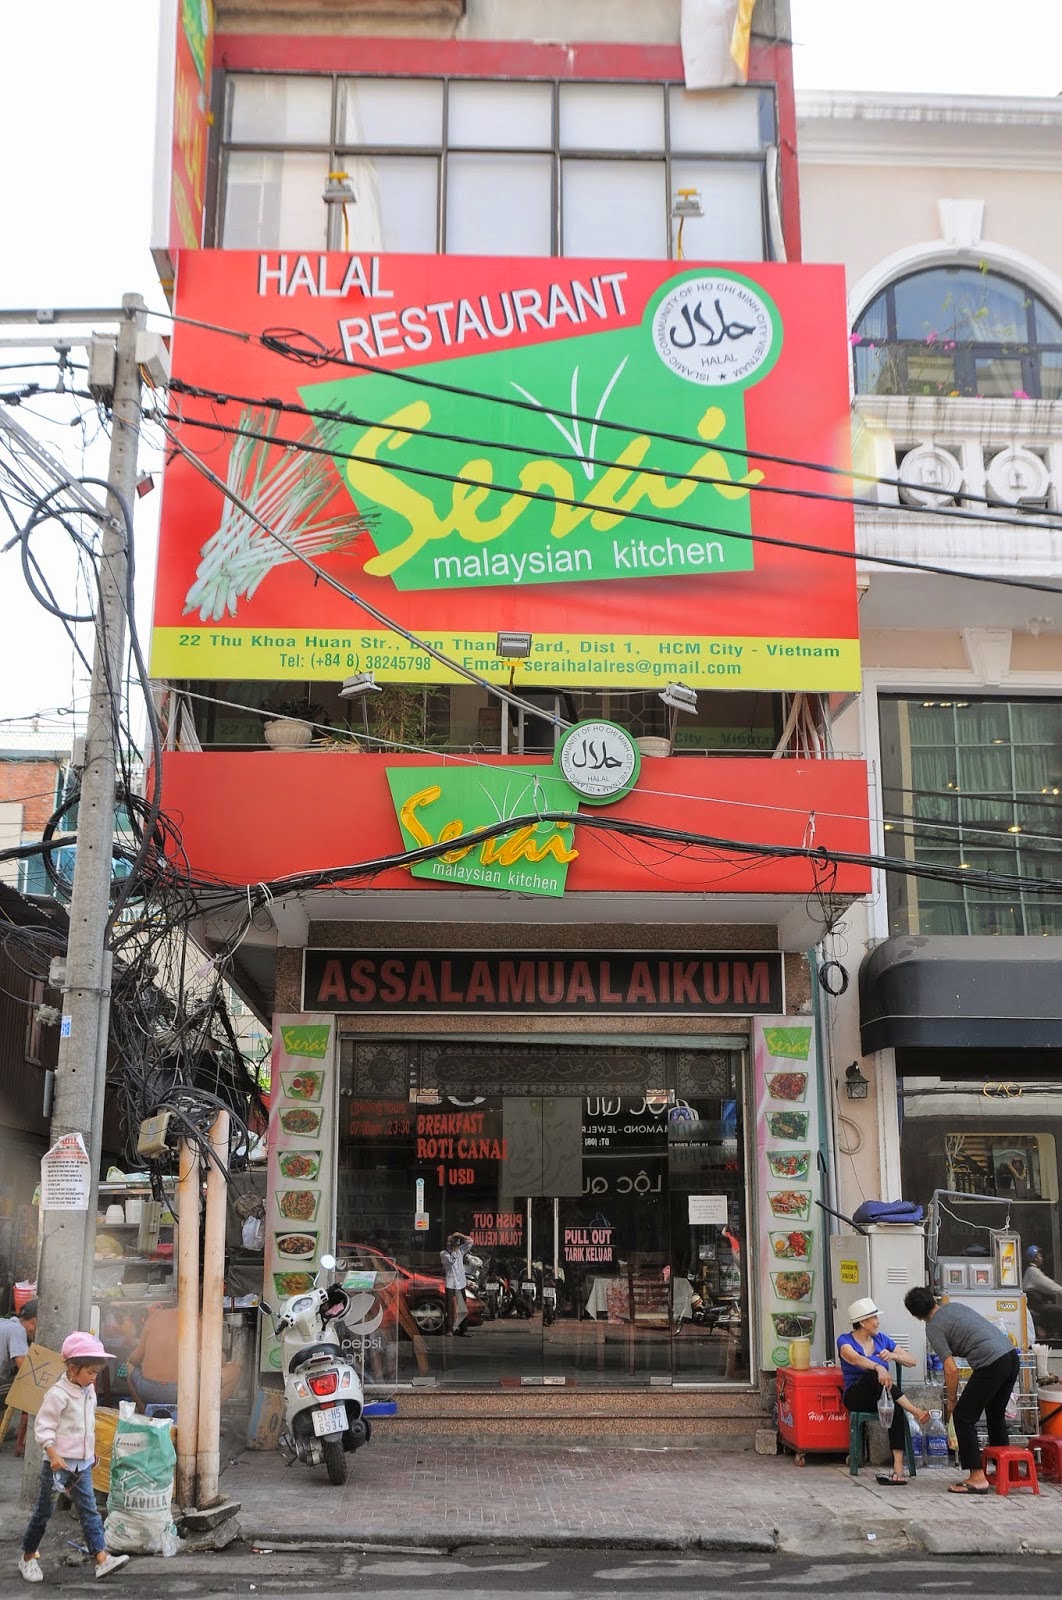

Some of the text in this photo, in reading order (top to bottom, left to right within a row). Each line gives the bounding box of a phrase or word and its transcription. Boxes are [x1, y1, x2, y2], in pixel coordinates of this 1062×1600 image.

[257, 254, 394, 298] HALAL
[337, 271, 629, 362] RESTAURANT
[669, 299, 757, 349] حلال
[658, 283, 768, 381] ISLAMIC COMMUNITY OF HO CHI MINH CITY VIETNAM
[700, 353, 738, 367] HALAL
[432, 538, 725, 582] malaysian kitchen
[178, 634, 201, 647] 22
[209, 634, 242, 647] Thu
[251, 635, 297, 648] Khoa
[304, 635, 351, 648] Huan
[360, 636, 400, 651] Str.,
[452, 637, 497, 651] Than
[580, 639, 619, 653] Dist
[623, 639, 641, 655] 1,
[658, 642, 701, 655] HCM
[709, 643, 744, 658] City
[766, 643, 841, 657] Vietnam
[280, 653, 305, 668] Tel:
[310, 652, 341, 669] (+84
[346, 652, 360, 670] 8)
[365, 655, 432, 671] 38245798
[523, 657, 742, 677] seraihalalres@gmail.com
[581, 726, 591, 735] OF
[605, 728, 618, 737] CHI
[564, 732, 581, 772] COMMUNITY
[572, 739, 623, 769] حلال
[618, 735, 631, 753] MINH
[569, 773, 595, 793] ISLAMIC
[602, 771, 630, 792] VIETNAM
[432, 863, 558, 891] malaysian kitchen
[317, 958, 771, 1005] ASSALAMUALAIKUM
[284, 1030, 330, 1052] Serai
[417, 1111, 485, 1136] BREAKFAST
[416, 1136, 508, 1160] ROTI CANAI
[436, 1164, 475, 1187] 1 USD
[564, 1229, 612, 1245] PULL OUT
[564, 1247, 613, 1262] TARIK KELUAR
[341, 1336, 382, 1350] pepsi
